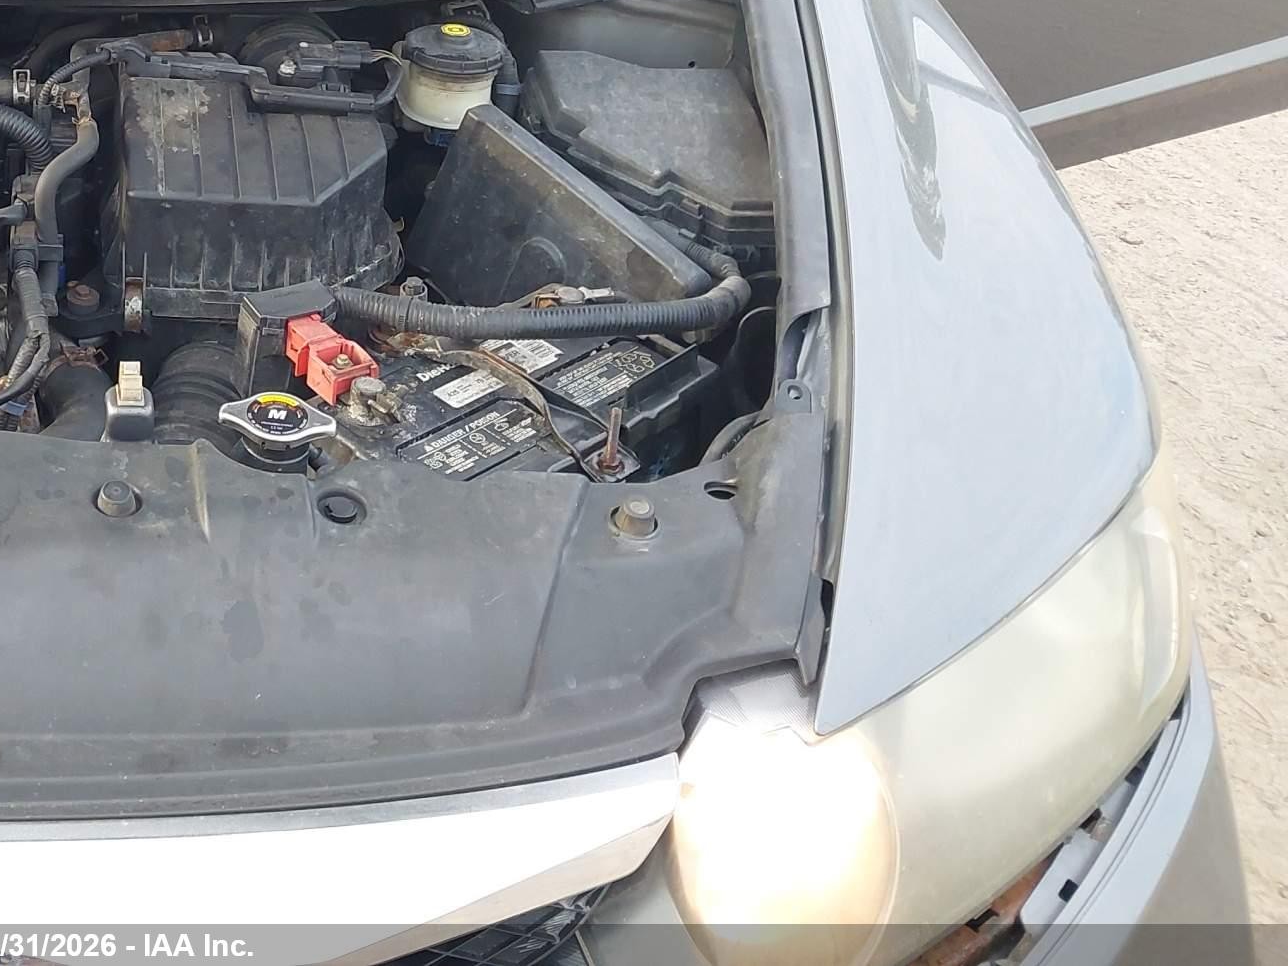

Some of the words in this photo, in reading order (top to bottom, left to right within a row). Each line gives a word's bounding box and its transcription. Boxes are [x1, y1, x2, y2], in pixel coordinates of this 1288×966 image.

[267, 409, 288, 421] M
[432, 428, 466, 448] DANGER
[470, 411, 501, 430] POISON
